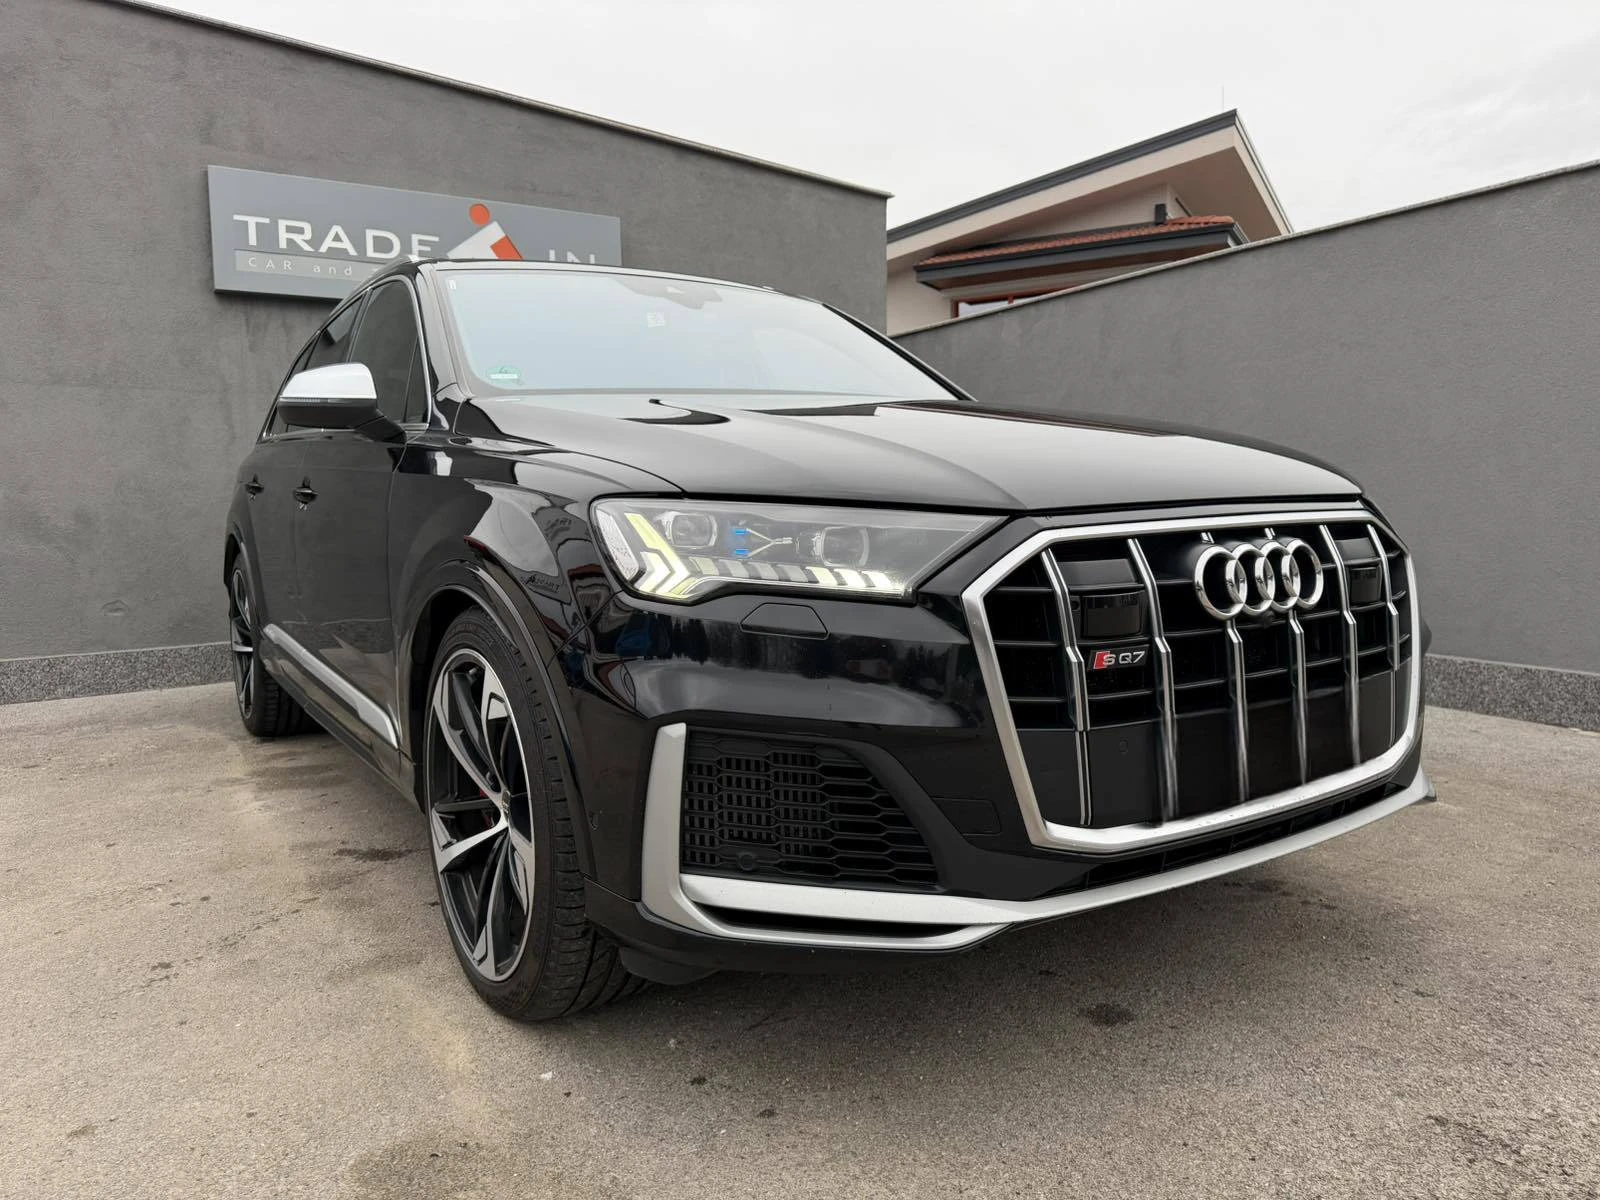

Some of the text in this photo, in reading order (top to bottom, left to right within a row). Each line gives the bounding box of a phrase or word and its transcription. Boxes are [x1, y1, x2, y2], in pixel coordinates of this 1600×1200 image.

[233, 214, 440, 259] TRADE
[248, 257, 352, 276] CAR and
